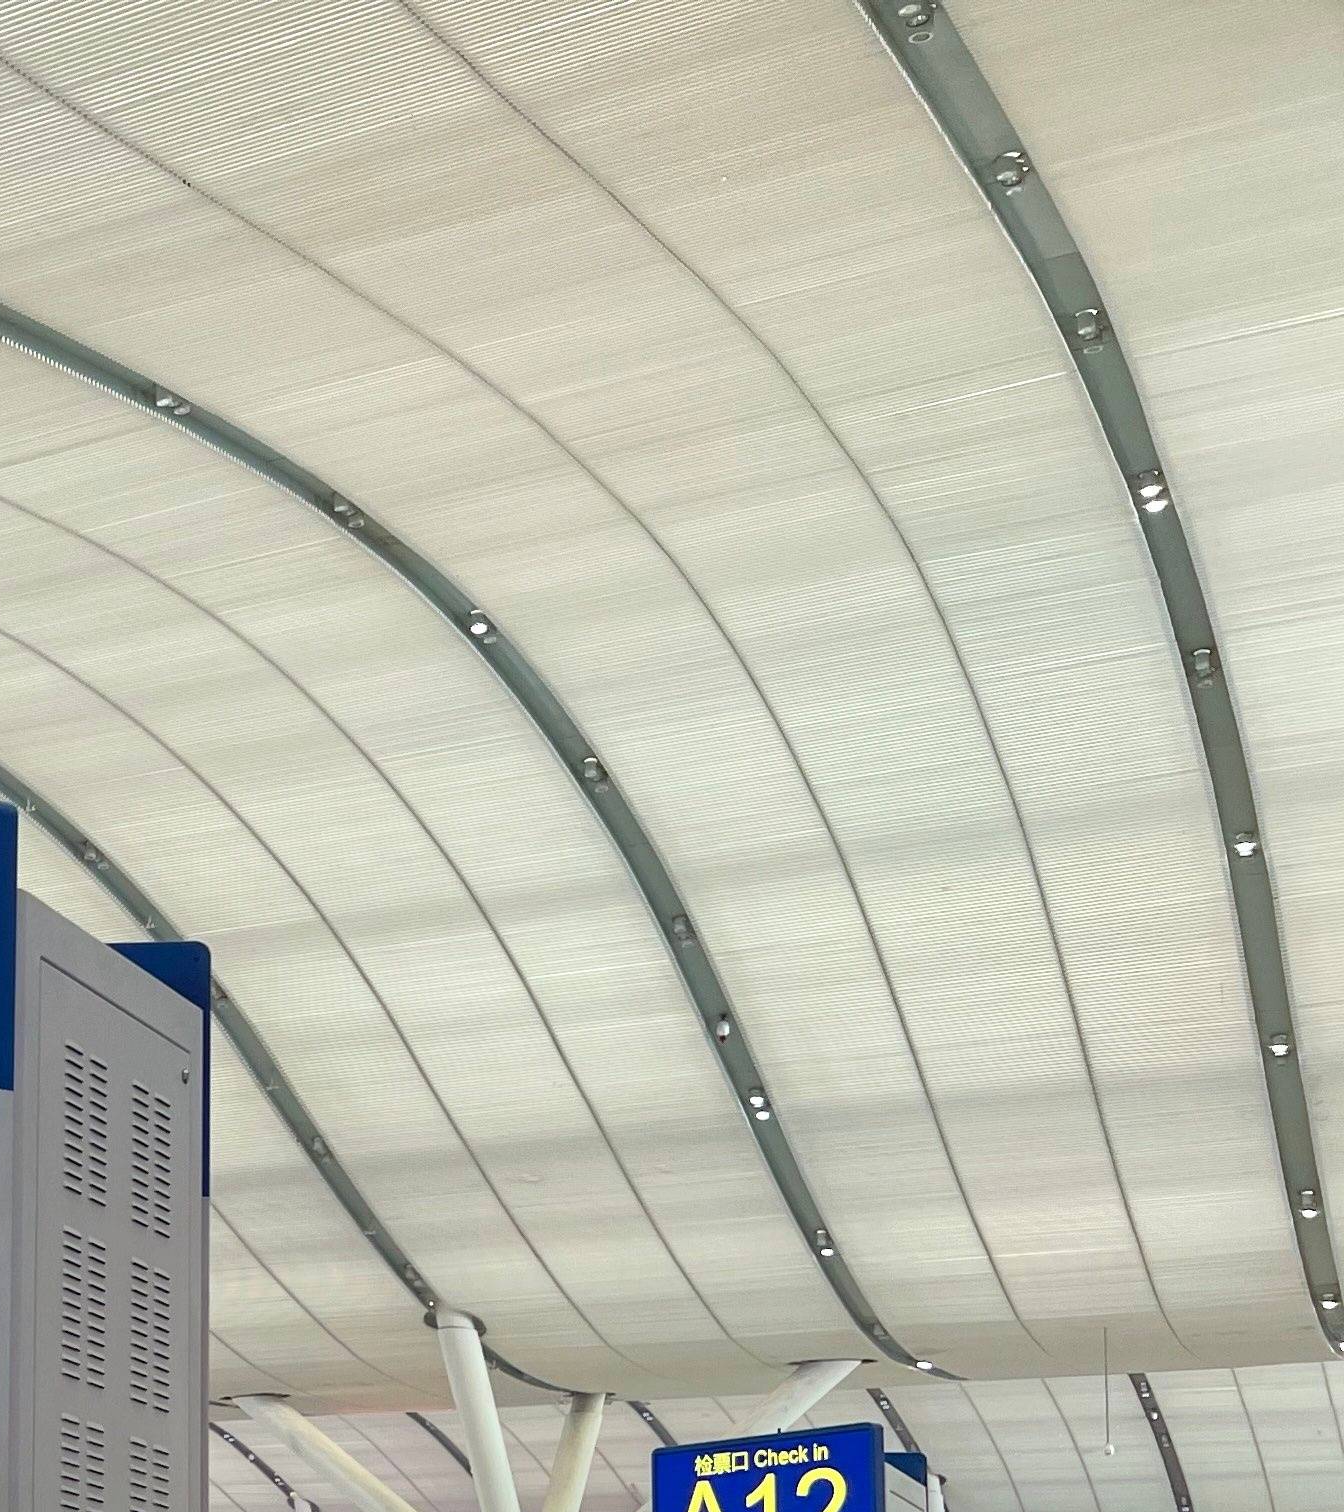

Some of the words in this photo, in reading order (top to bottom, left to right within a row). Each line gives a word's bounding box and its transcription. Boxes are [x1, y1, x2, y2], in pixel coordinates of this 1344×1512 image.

[694, 1452, 749, 1476] 检票口
[753, 1445, 809, 1468] Check
[813, 1443, 829, 1461] in
